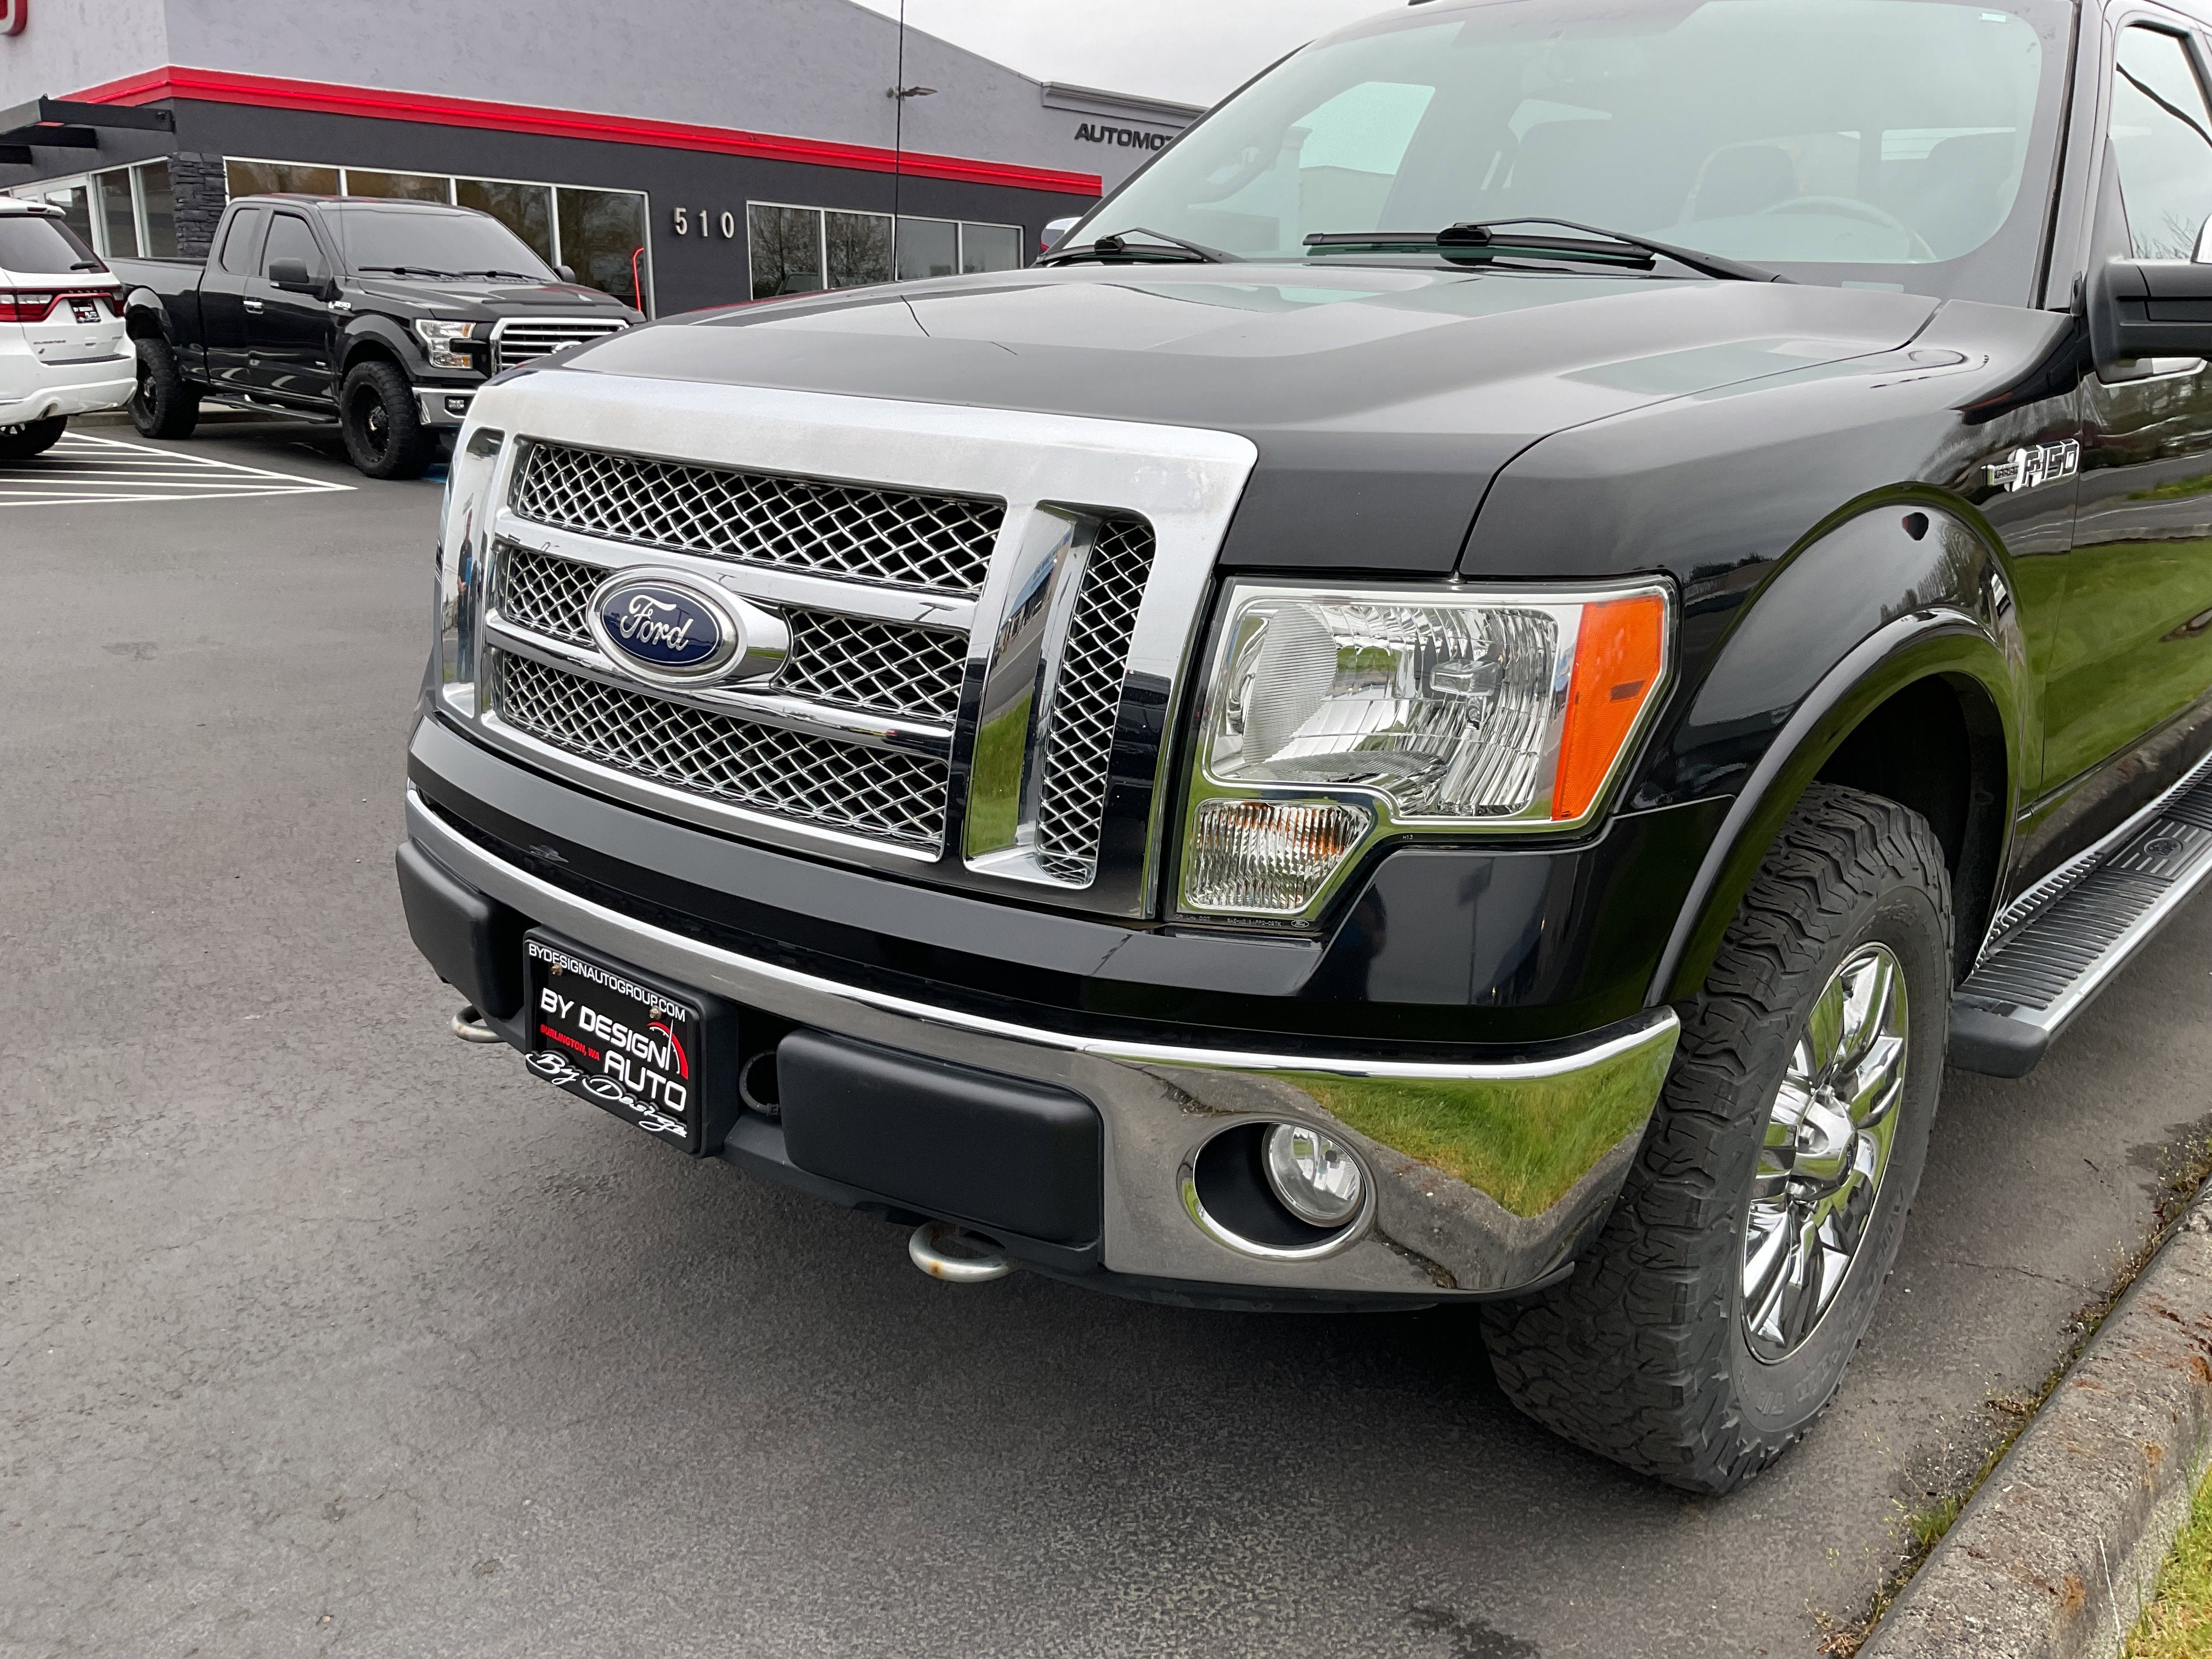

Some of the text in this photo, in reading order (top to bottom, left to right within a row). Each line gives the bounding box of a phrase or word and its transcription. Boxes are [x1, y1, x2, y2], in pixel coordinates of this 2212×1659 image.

[674, 207, 735, 239] 510
[619, 594, 694, 651] Ford
[529, 944, 685, 1022] BYDESIGNAUTOGROUPCOM
[540, 987, 668, 1069] BY DESIGN
[588, 1047, 600, 1062] WA
[526, 1053, 687, 1138] By Design
[604, 1050, 687, 1112] AUTO
